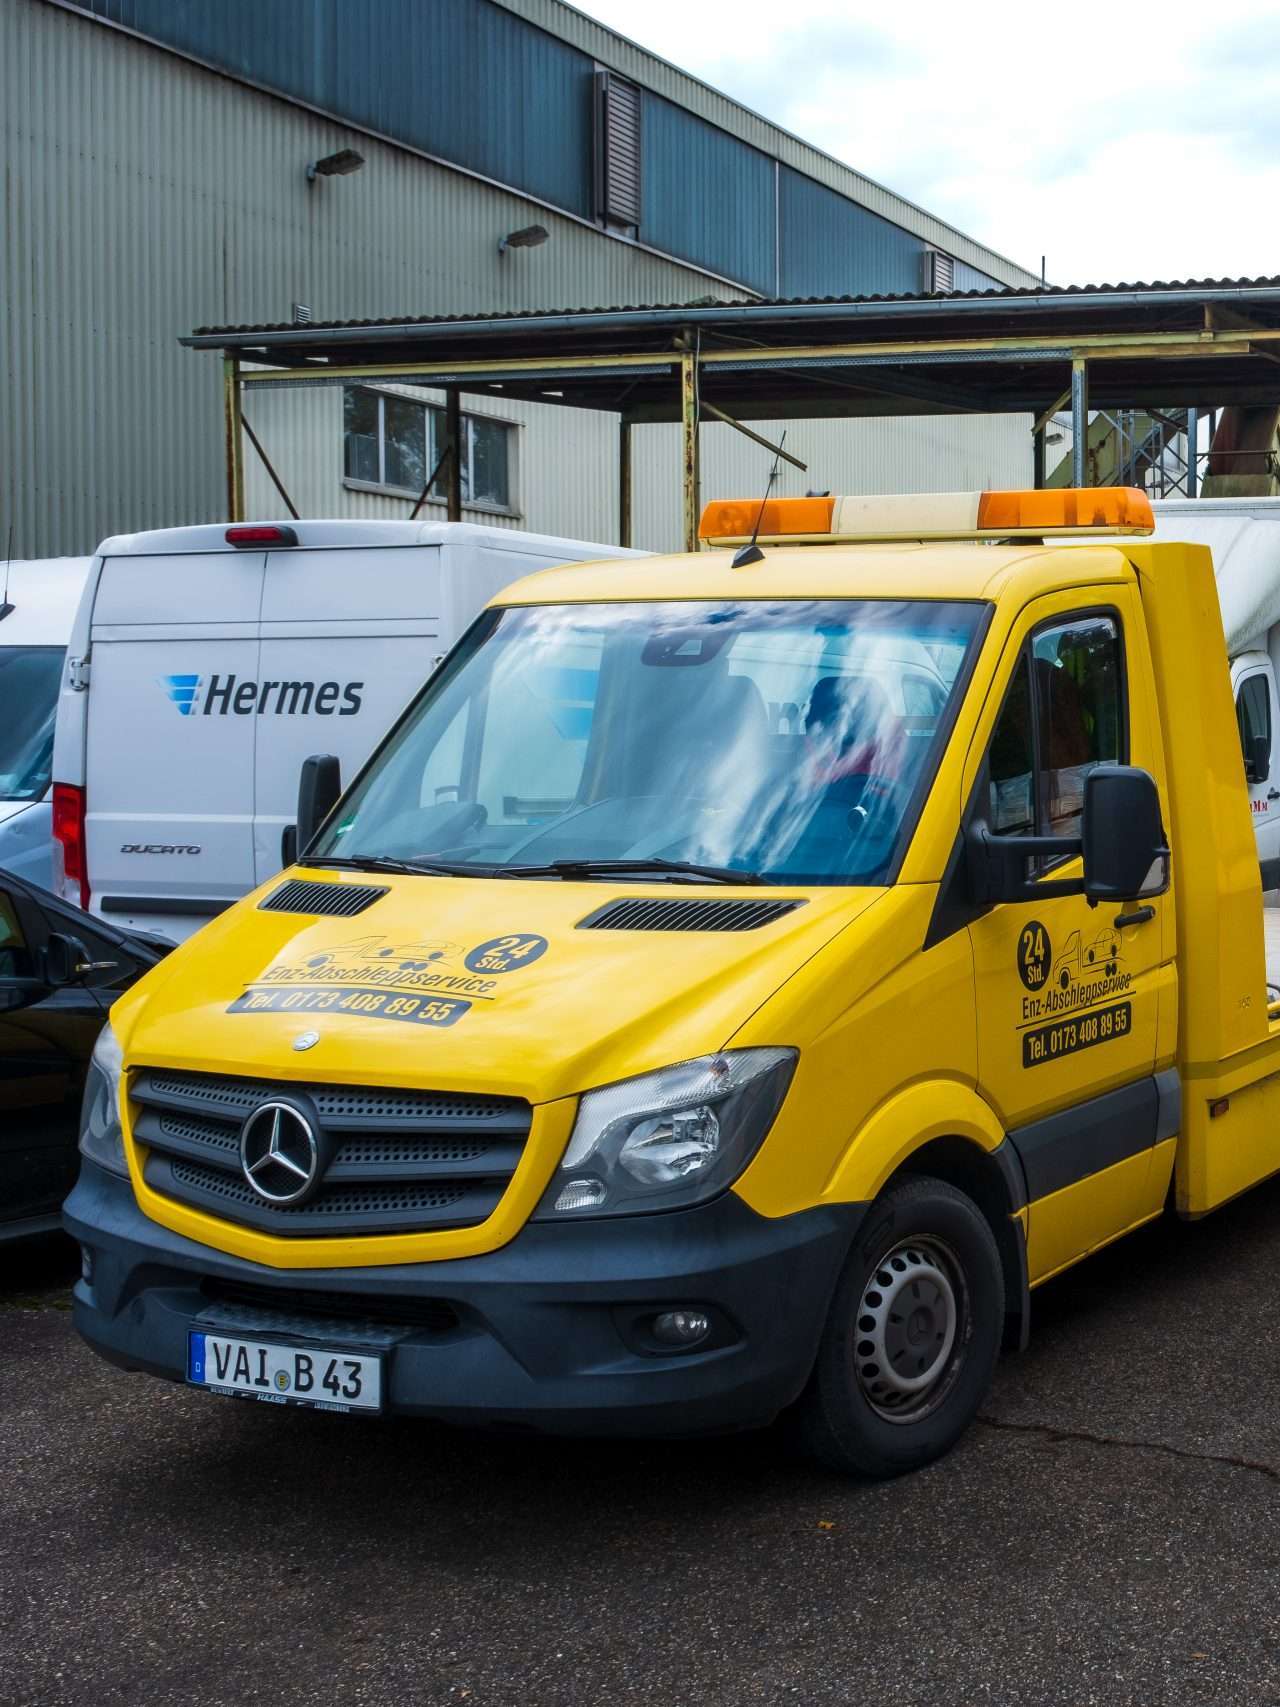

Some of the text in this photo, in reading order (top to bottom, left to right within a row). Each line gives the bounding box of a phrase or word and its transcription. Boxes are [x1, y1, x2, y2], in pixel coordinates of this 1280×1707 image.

[203, 674, 364, 716] Hermes
[120, 844, 202, 855] DUCATO
[490, 937, 531, 960] 24
[1023, 928, 1045, 965] 24
[474, 955, 508, 972] Std.
[1027, 964, 1045, 984] Std.
[262, 964, 497, 993] Enz-Abschleppservice
[242, 992, 457, 1021] Tel. 0173 408 89 55
[1023, 971, 1132, 1020] Enz-Abschleppservice
[1028, 1008, 1127, 1060] Tel. 0173 408 89 55
[213, 1342, 362, 1400] VAI B 43
